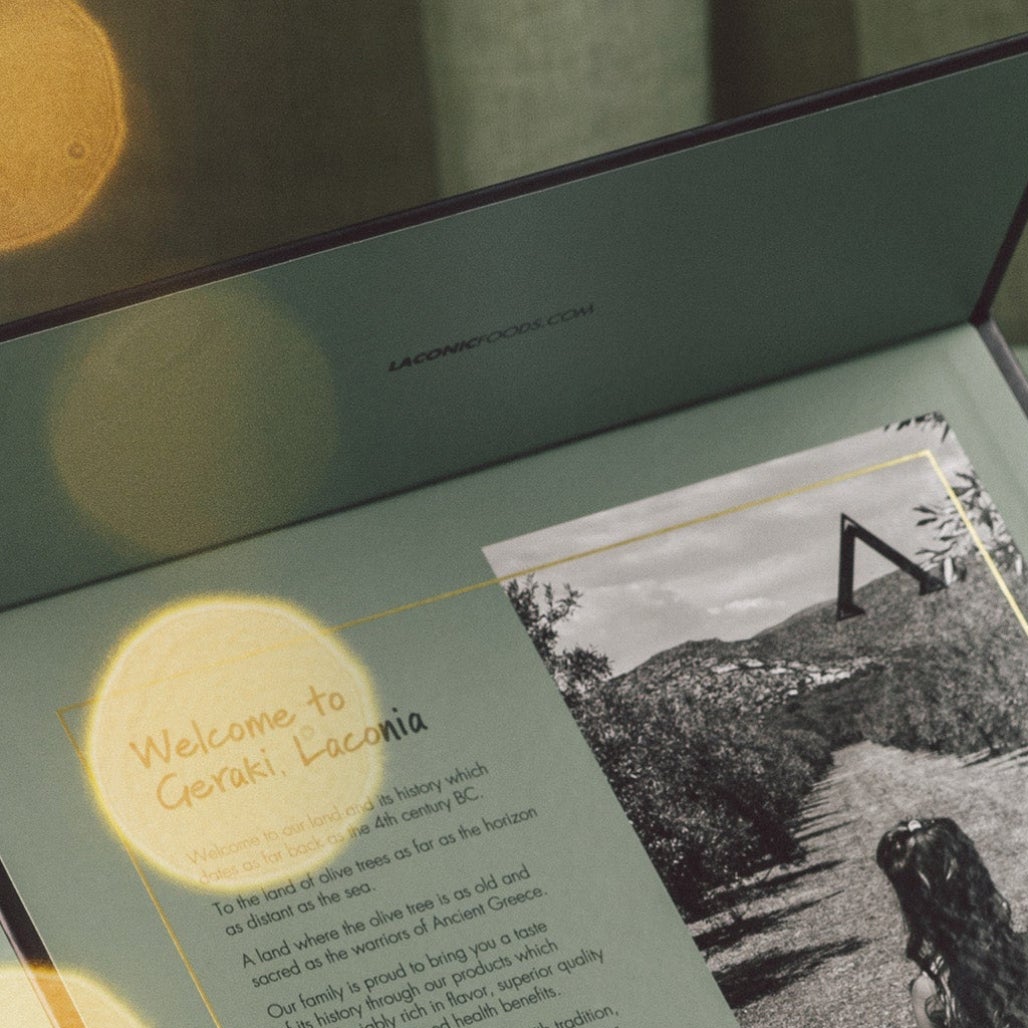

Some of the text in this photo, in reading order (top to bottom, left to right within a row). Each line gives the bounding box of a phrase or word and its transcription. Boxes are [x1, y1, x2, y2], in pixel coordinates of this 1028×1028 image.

[130, 685, 345, 770] Welcome to
[156, 708, 428, 811] Geraki, Laconia
[211, 807, 538, 917] To the land of olive trees as far as the horizon
[225, 882, 376, 937] as distant as the sea.
[242, 862, 531, 969] A land where the olive tree is as old and
[251, 887, 548, 988] sacred as the warriors of Ancient Greece.
[266, 922, 548, 1019] Our family is proud to bring you a taste
[313, 1003, 362, 1027] history
[364, 981, 421, 1011] through
[423, 976, 447, 992] our
[450, 956, 513, 988] products
[513, 937, 559, 963] which
[399, 1002, 428, 1023] rich
[428, 1000, 446, 1013] in
[445, 985, 494, 1008] flavor,
[496, 964, 553, 992] superior
[556, 948, 604, 975] quality
[450, 1002, 499, 1028] health
[497, 985, 562, 1013] benefits.
